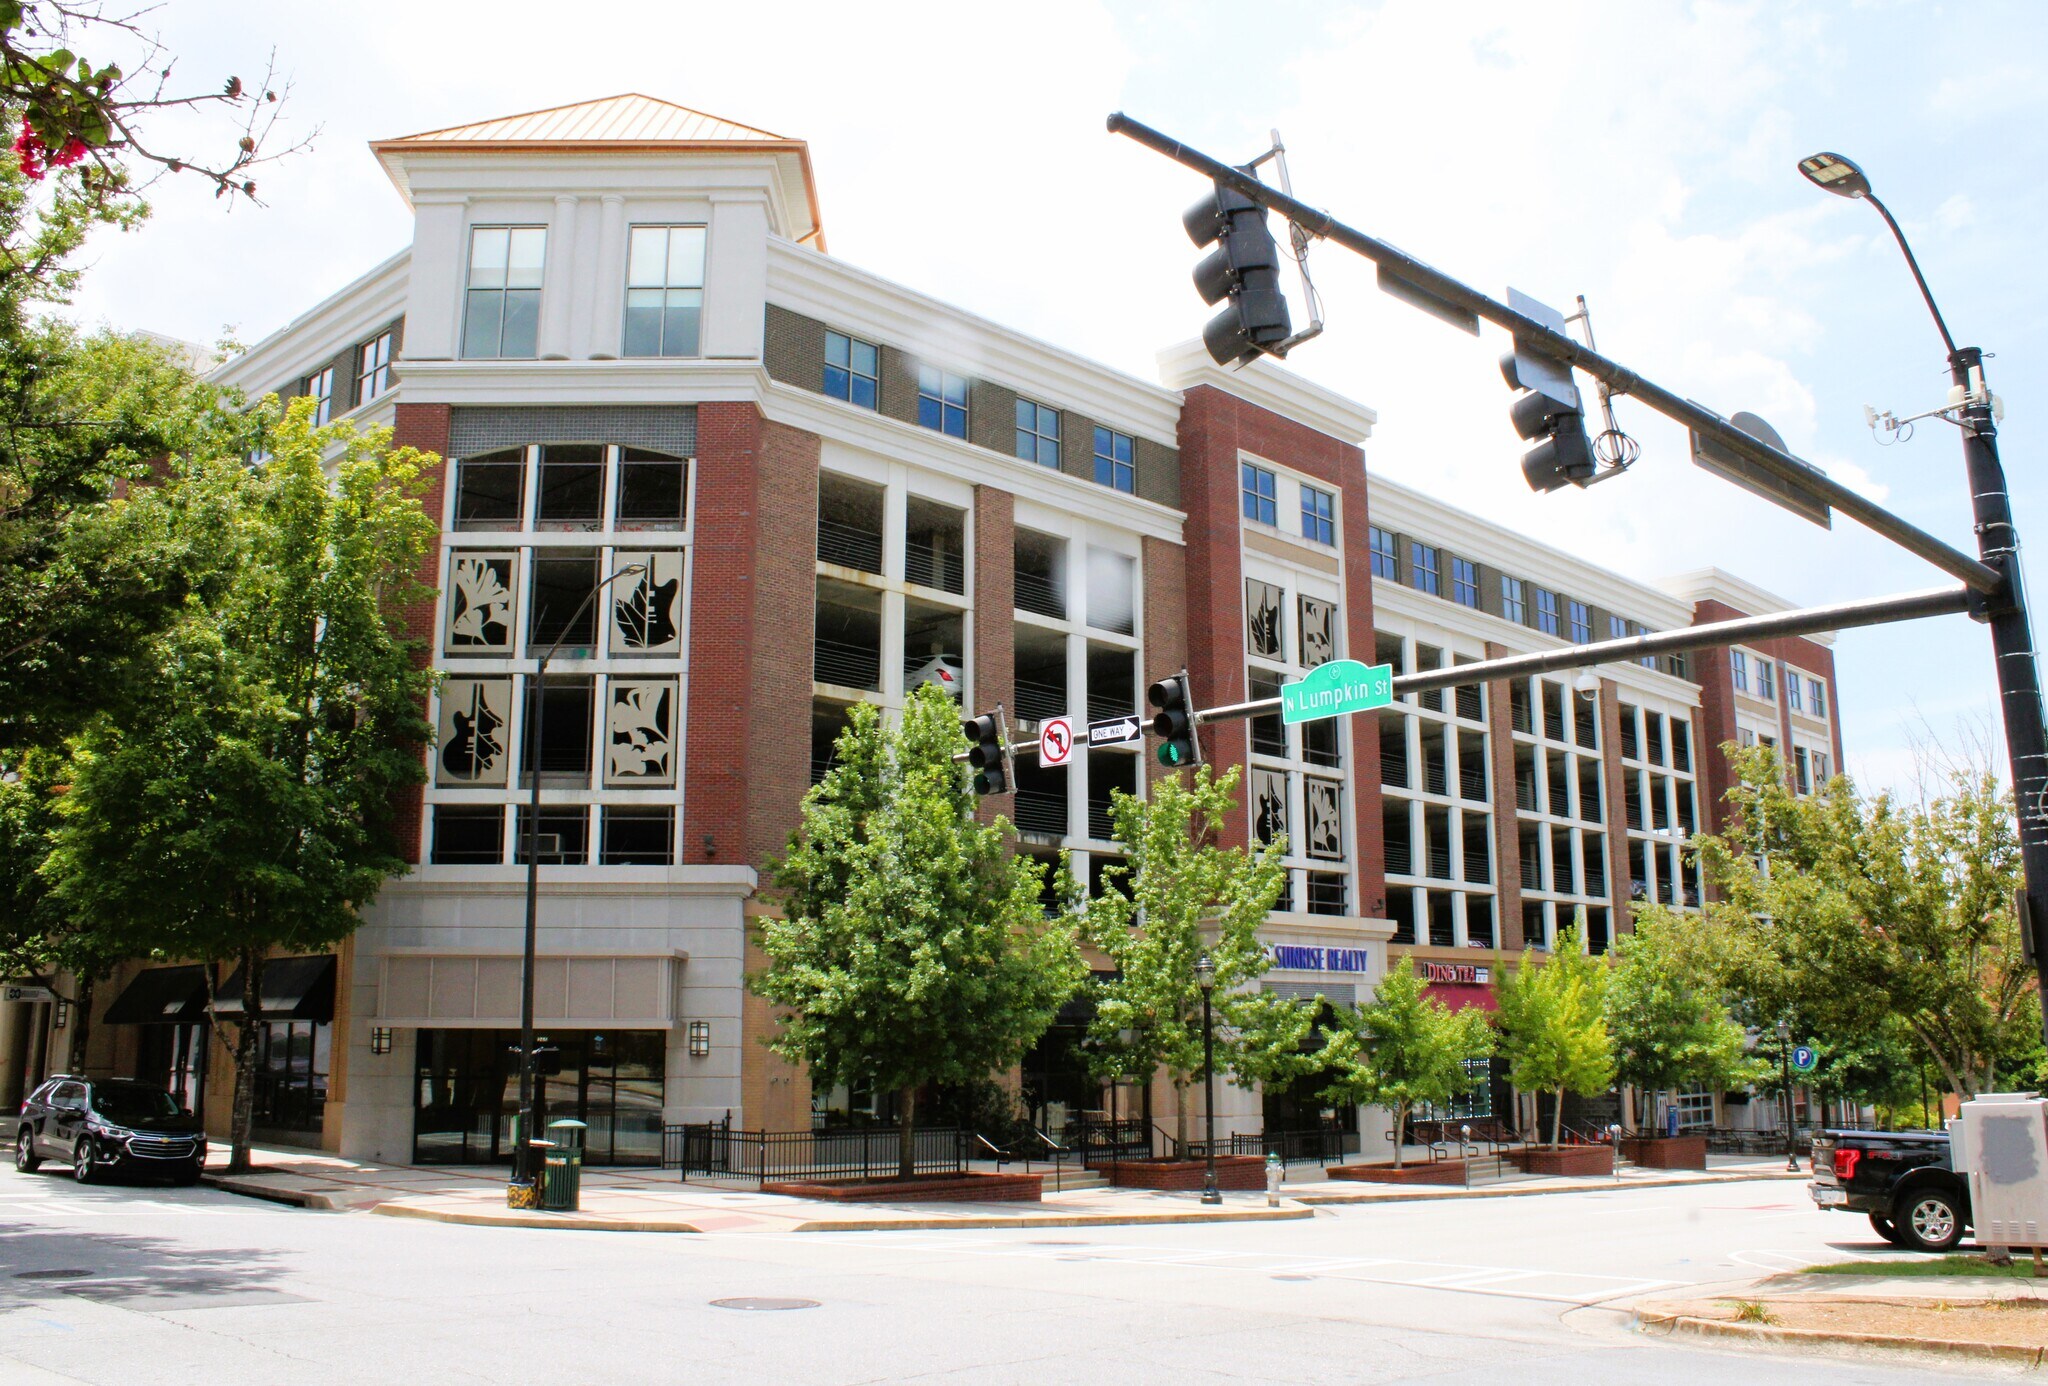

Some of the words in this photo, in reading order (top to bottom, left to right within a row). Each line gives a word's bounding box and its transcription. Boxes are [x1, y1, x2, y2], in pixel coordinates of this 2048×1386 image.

[1286, 697, 1295, 713] N
[1299, 680, 1369, 710] Lumpkin
[1375, 679, 1388, 696] St
[1093, 729, 1108, 740] ONE
[1110, 725, 1125, 737] WAY
[1275, 945, 1325, 970] SUNRISE
[1327, 948, 1368, 972] REALTY
[1427, 962, 1456, 982] DING
[1456, 965, 1475, 983] TEA
[1798, 1050, 1808, 1065] P
